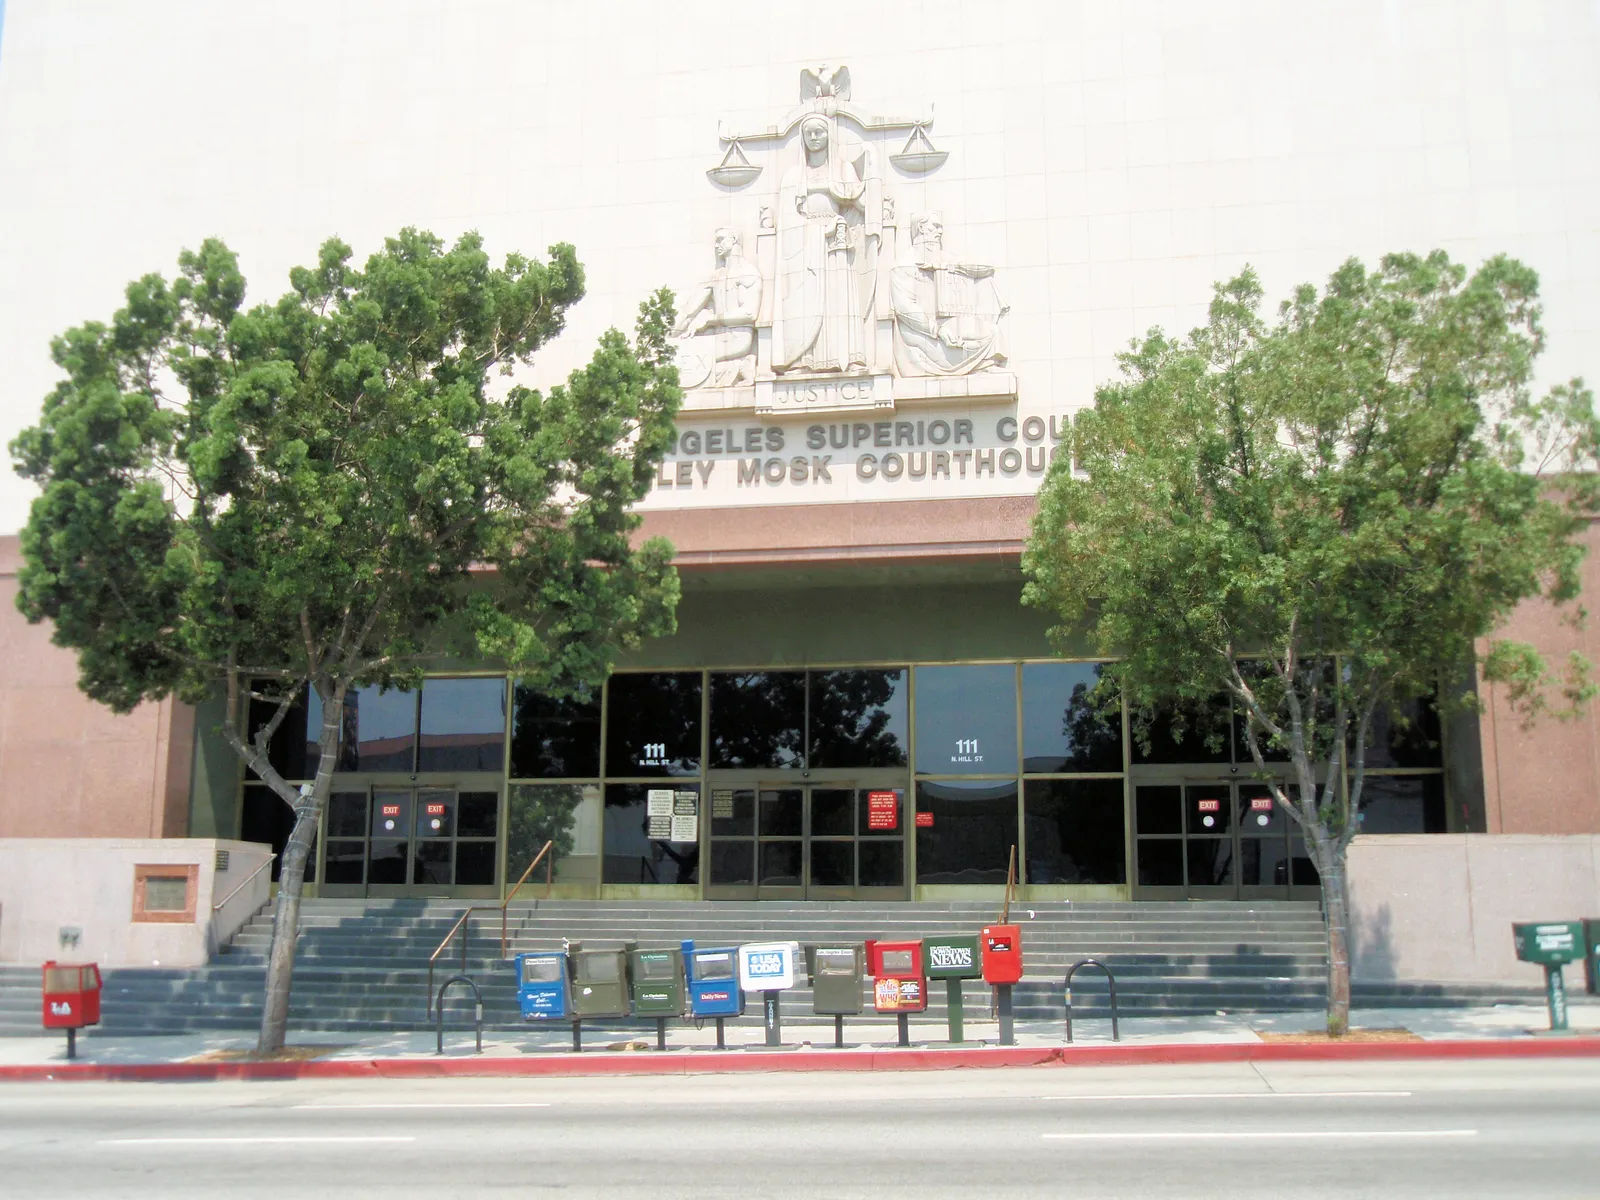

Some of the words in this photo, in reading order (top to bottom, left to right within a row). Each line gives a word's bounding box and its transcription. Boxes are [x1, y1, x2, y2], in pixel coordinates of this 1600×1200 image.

[778, 381, 869, 404] JUSTICE
[806, 417, 973, 450] SUPERIOR
[996, 414, 1078, 442] COU
[737, 455, 832, 485] MOSK
[855, 446, 1086, 478] COURTHOU
[643, 743, 666, 758] 111
[955, 739, 977, 754] 111
[383, 806, 398, 814] EXIT
[427, 805, 443, 813] EXIT
[1200, 801, 1216, 809] EXIT
[1253, 800, 1269, 808] EXIT
[760, 954, 780, 964] USA
[930, 953, 972, 966] NEWS
[750, 963, 782, 975] TODAY
